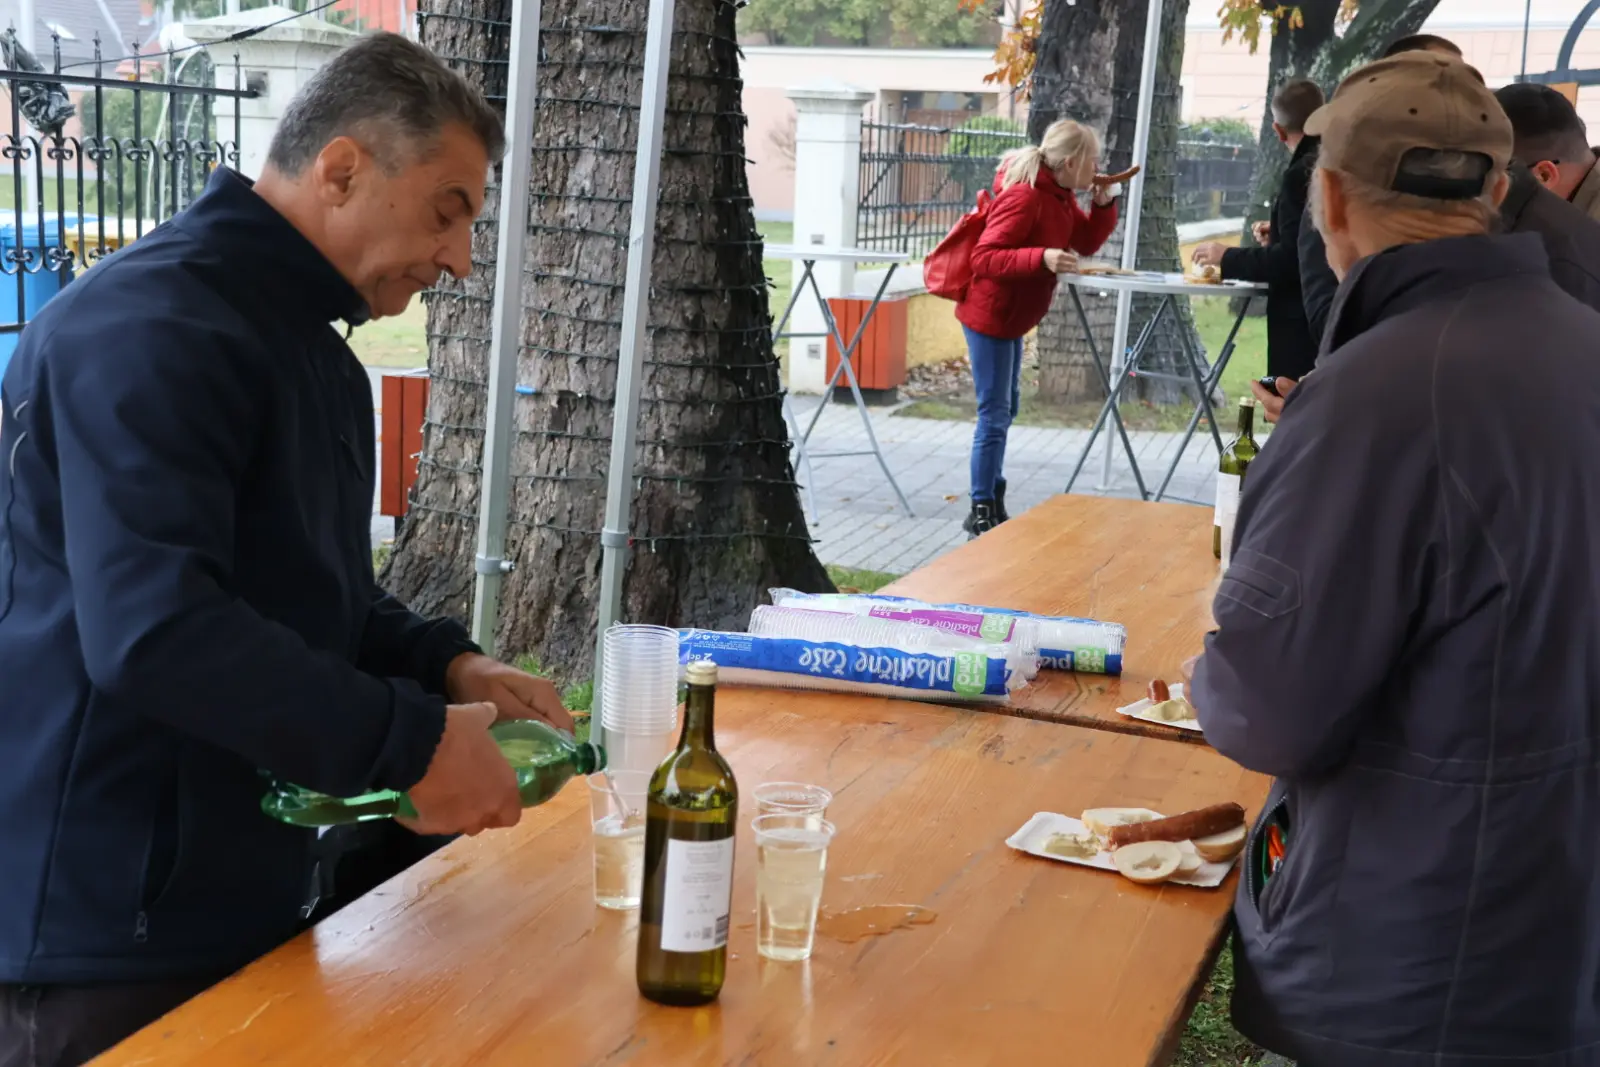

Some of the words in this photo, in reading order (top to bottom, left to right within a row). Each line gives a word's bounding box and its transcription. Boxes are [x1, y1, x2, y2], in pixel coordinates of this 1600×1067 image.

[799, 647, 847, 675] čaše
[855, 651, 951, 687] plastične
[957, 674, 983, 687] TO
